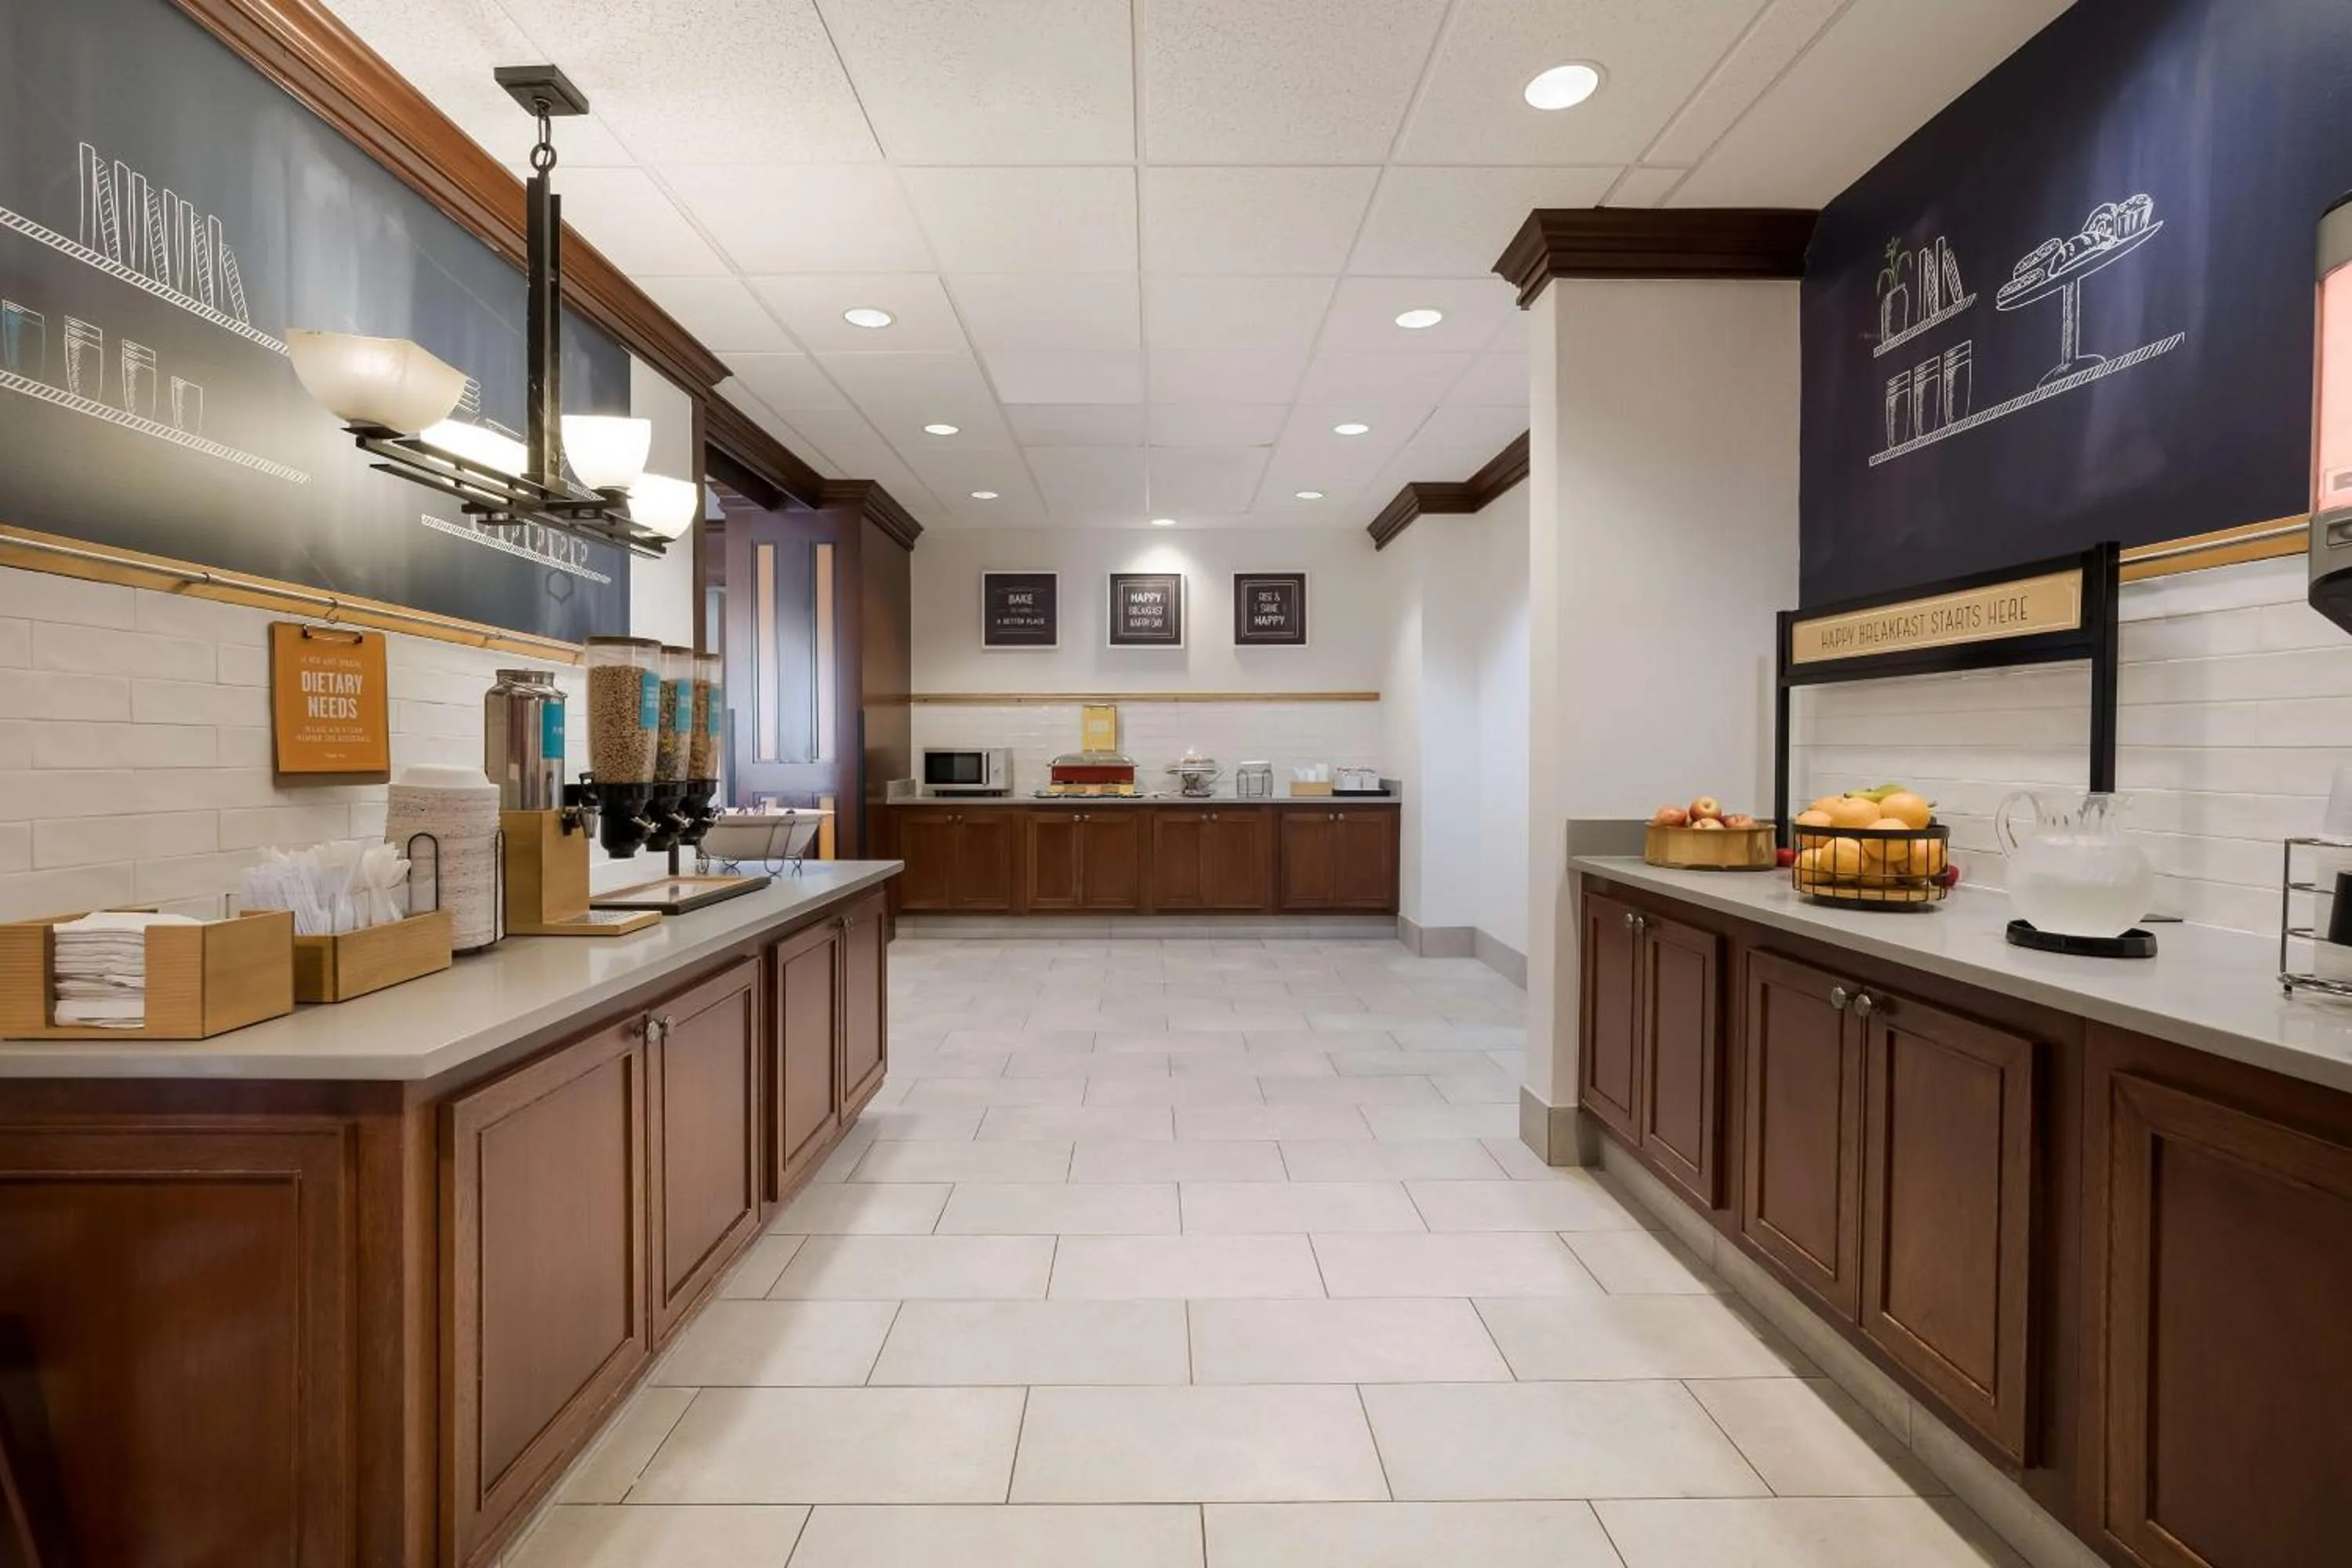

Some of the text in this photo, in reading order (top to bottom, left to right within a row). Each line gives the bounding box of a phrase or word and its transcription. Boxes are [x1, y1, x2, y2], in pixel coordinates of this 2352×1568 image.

[1130, 592, 1161, 603] HAPPY
[1254, 615, 1285, 626] HAPPY
[1821, 596, 2028, 650] HAPPY BREAKFAST STARTS HERE
[301, 670, 363, 695] DIETARY
[307, 695, 358, 719] NEEDS
